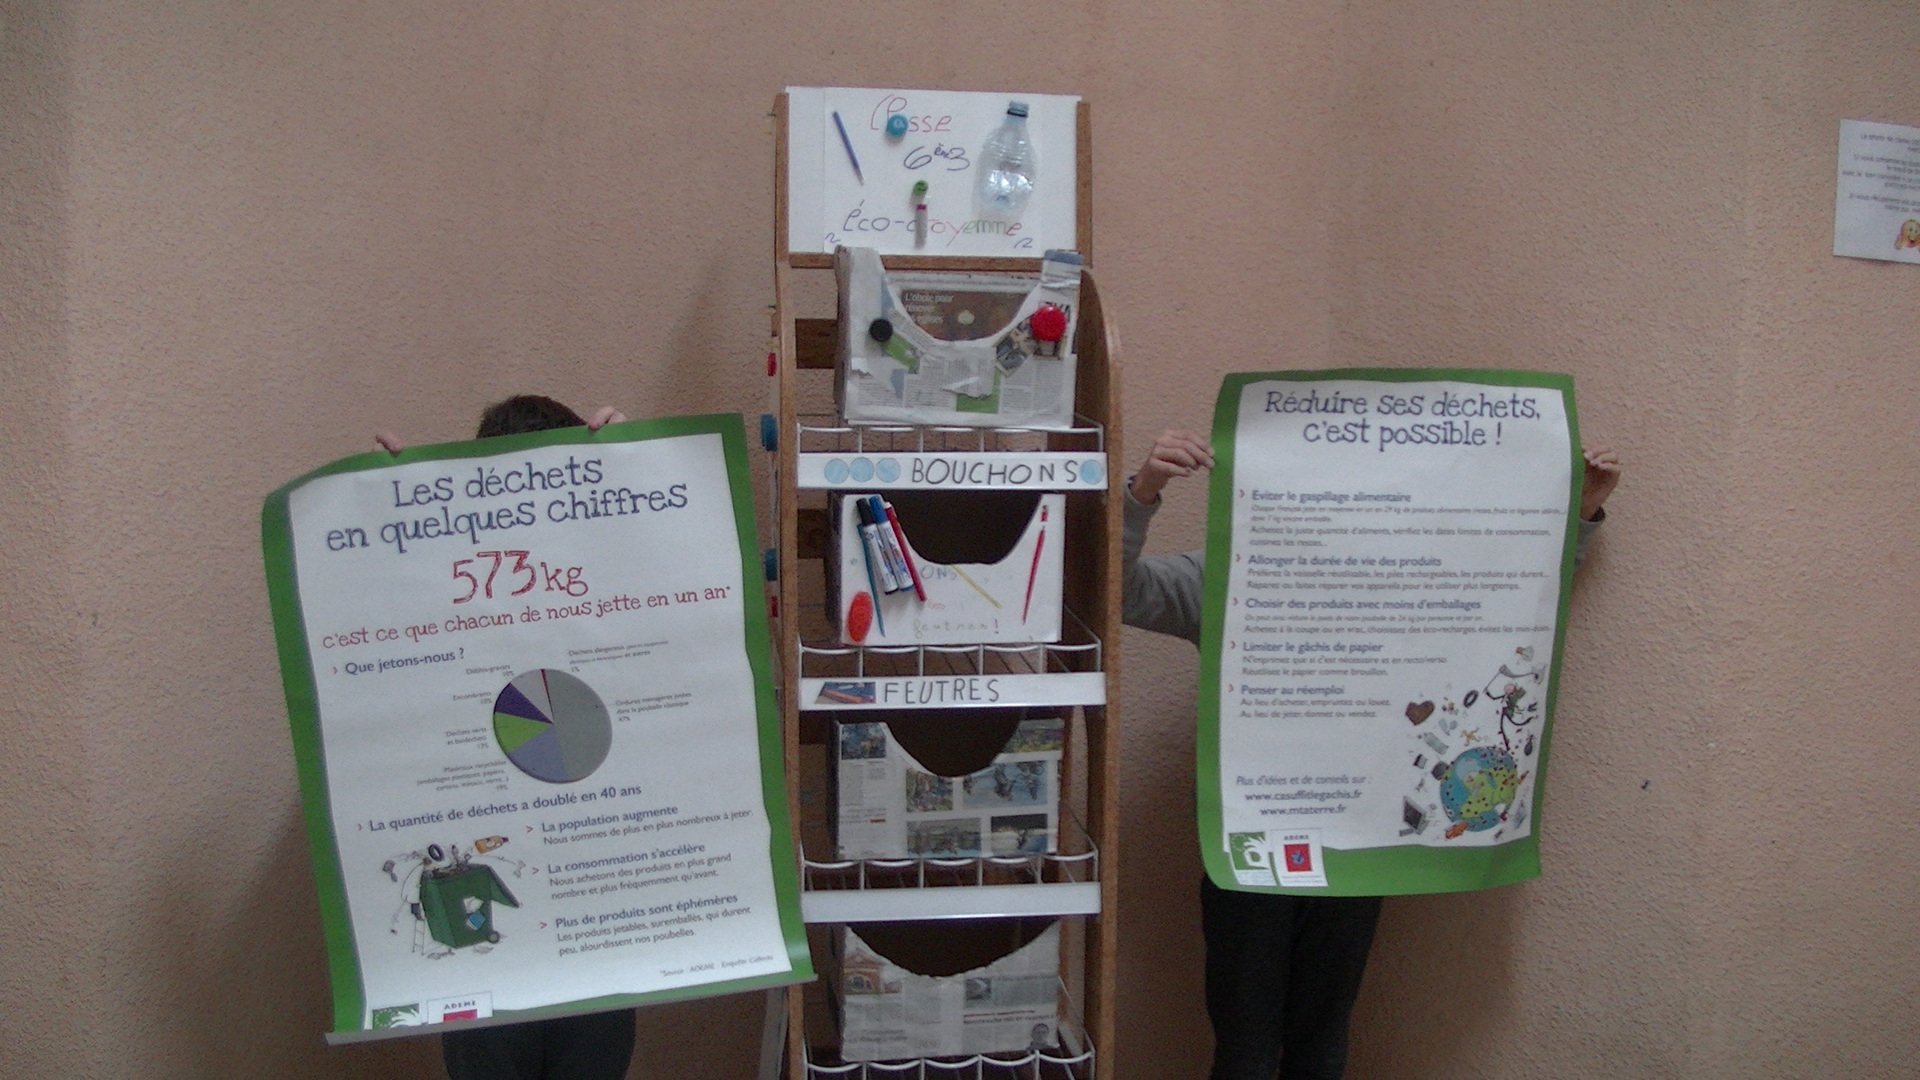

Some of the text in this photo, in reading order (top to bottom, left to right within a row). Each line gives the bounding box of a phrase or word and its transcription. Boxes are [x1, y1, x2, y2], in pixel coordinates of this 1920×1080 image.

[870, 93, 952, 133] Clsse
[1264, 389, 1540, 420] Réduire ses déchets,
[1303, 418, 1502, 452] c'est possible !
[392, 456, 603, 508] Les déchets
[912, 457, 1079, 485] BOUCHONS
[1287, 490, 1297, 500] le
[1300, 491, 1350, 504] gaspillage
[1353, 491, 1411, 502] alimentaire
[326, 483, 688, 554] en quelques chiffres
[1248, 555, 1442, 569] Allonger la durée de vie des produits
[1287, 599, 1306, 609] des
[1308, 599, 1354, 611] produits
[1356, 601, 1380, 609] avec
[1383, 600, 1414, 609] moins
[1417, 599, 1481, 611] d'emballages
[322, 627, 369, 649] c'est
[375, 626, 399, 642] ce
[405, 622, 439, 643] que
[445, 612, 514, 633] chacun
[520, 606, 541, 623] de
[547, 601, 592, 620] nous
[596, 594, 642, 618] jette
[647, 595, 670, 608] en
[674, 591, 699, 604] un
[345, 647, 465, 676] Que jetons-nous ?
[1243, 641, 1282, 652] Limiter
[1285, 642, 1295, 652] le
[1332, 641, 1346, 652] de
[1349, 642, 1383, 654] papier
[884, 678, 999, 704] FEUTRES
[1241, 684, 1344, 697] Penser au réemploi
[1236, 776, 1254, 786] Plus
[1289, 775, 1299, 785] et
[1301, 775, 1313, 785] de
[1316, 774, 1349, 784] conseils
[369, 785, 642, 832] La quantité de déchets a doublé en 40 ans
[541, 806, 679, 833] La population augmente
[543, 835, 569, 846] Nous
[570, 830, 608, 842] sommes
[609, 827, 621, 837] de
[623, 825, 641, 836] plus
[643, 824, 654, 832] en
[656, 821, 674, 832] plus
[676, 813, 721, 827] nombreux
[547, 844, 706, 874] La consommation s'accélère
[549, 853, 732, 887] Nous achetons des produits en plus grand
[551, 888, 587, 900] nombre
[589, 887, 598, 896] et
[600, 884, 618, 896] plus
[620, 875, 679, 890] fréquemment
[555, 894, 738, 929] Plus de produits sont éphémères
[557, 932, 573, 942] Les
[575, 928, 612, 942] produits
[706, 911, 719, 922] qui
[721, 907, 751, 917] durent
[580, 937, 633, 952] alourdissent
[635, 935, 651, 944] nos
[444, 1000, 477, 1010] ADEME
